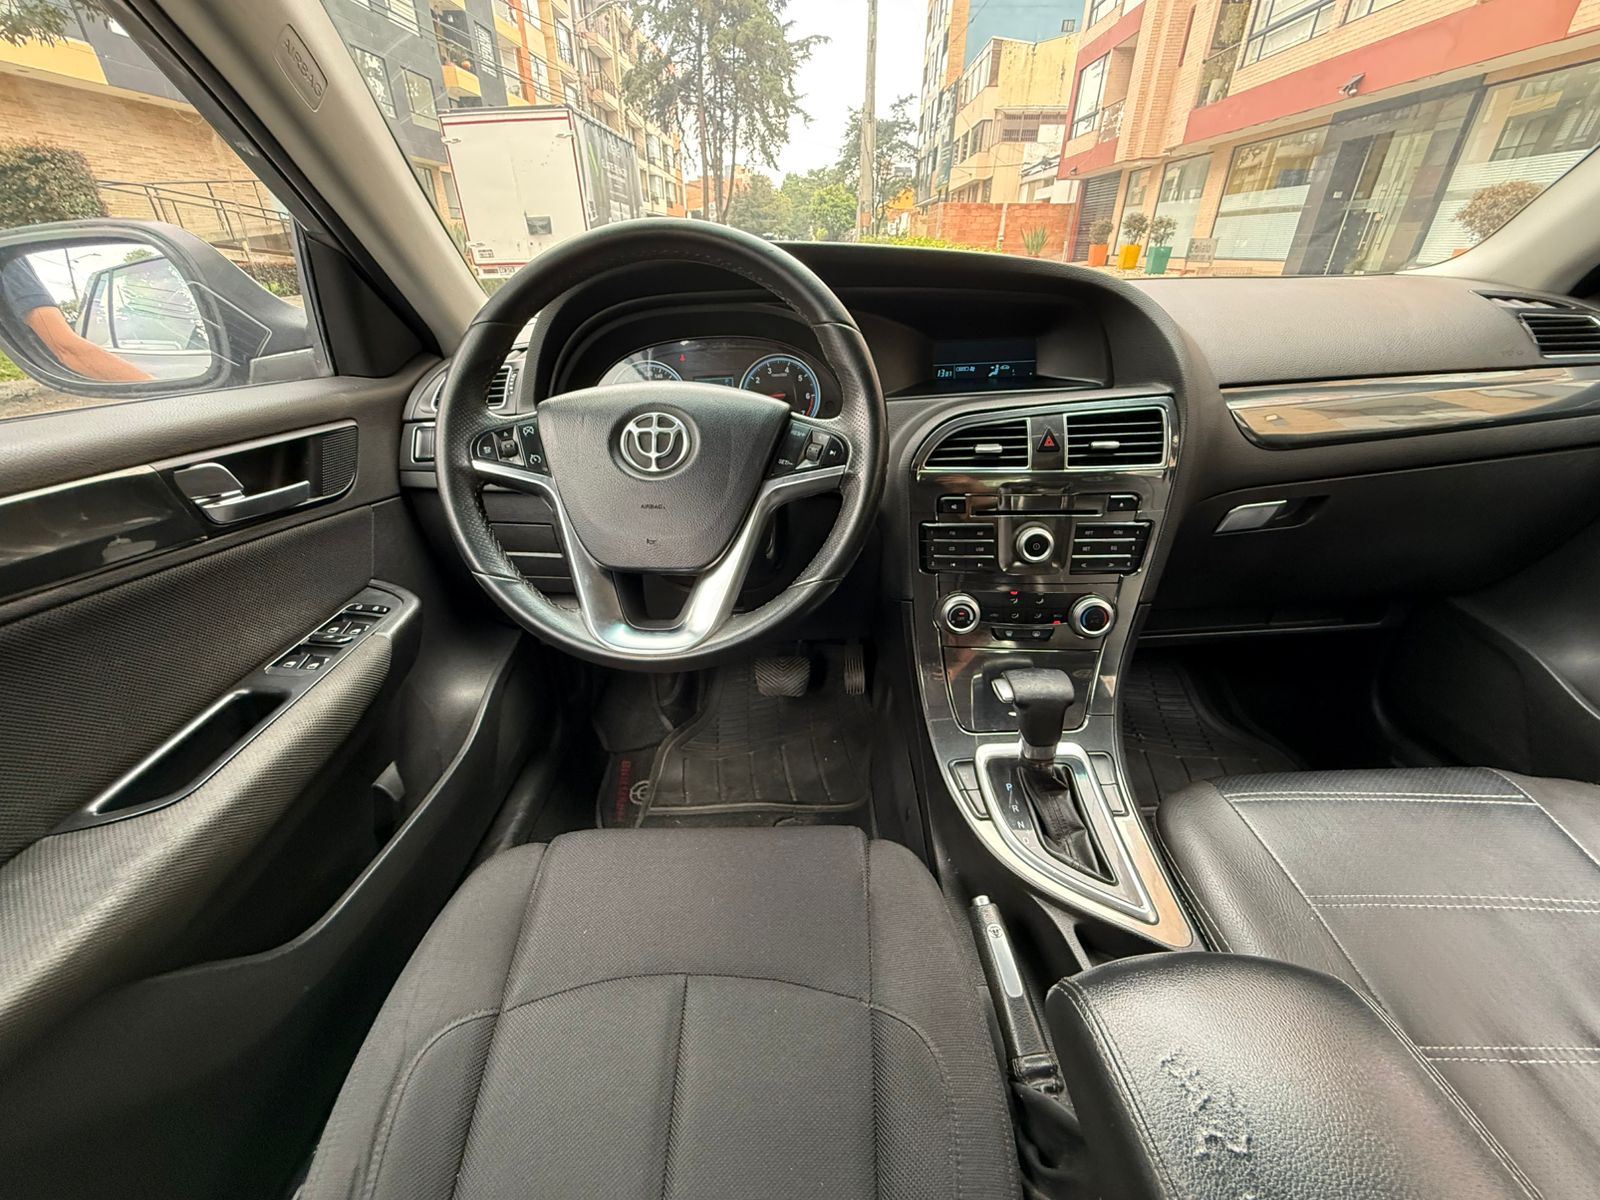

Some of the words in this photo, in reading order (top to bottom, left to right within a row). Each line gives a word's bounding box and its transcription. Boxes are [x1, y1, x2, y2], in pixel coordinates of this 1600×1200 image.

[283, 38, 323, 97] AIRBAG
[767, 367, 773, 375] 3
[784, 366, 790, 374] 4
[755, 376, 761, 384] 2
[797, 374, 803, 382] 5
[805, 392, 811, 400] 6
[1005, 783, 1013, 791] P
[1011, 804, 1019, 813] R
[1022, 836, 1030, 845] D
